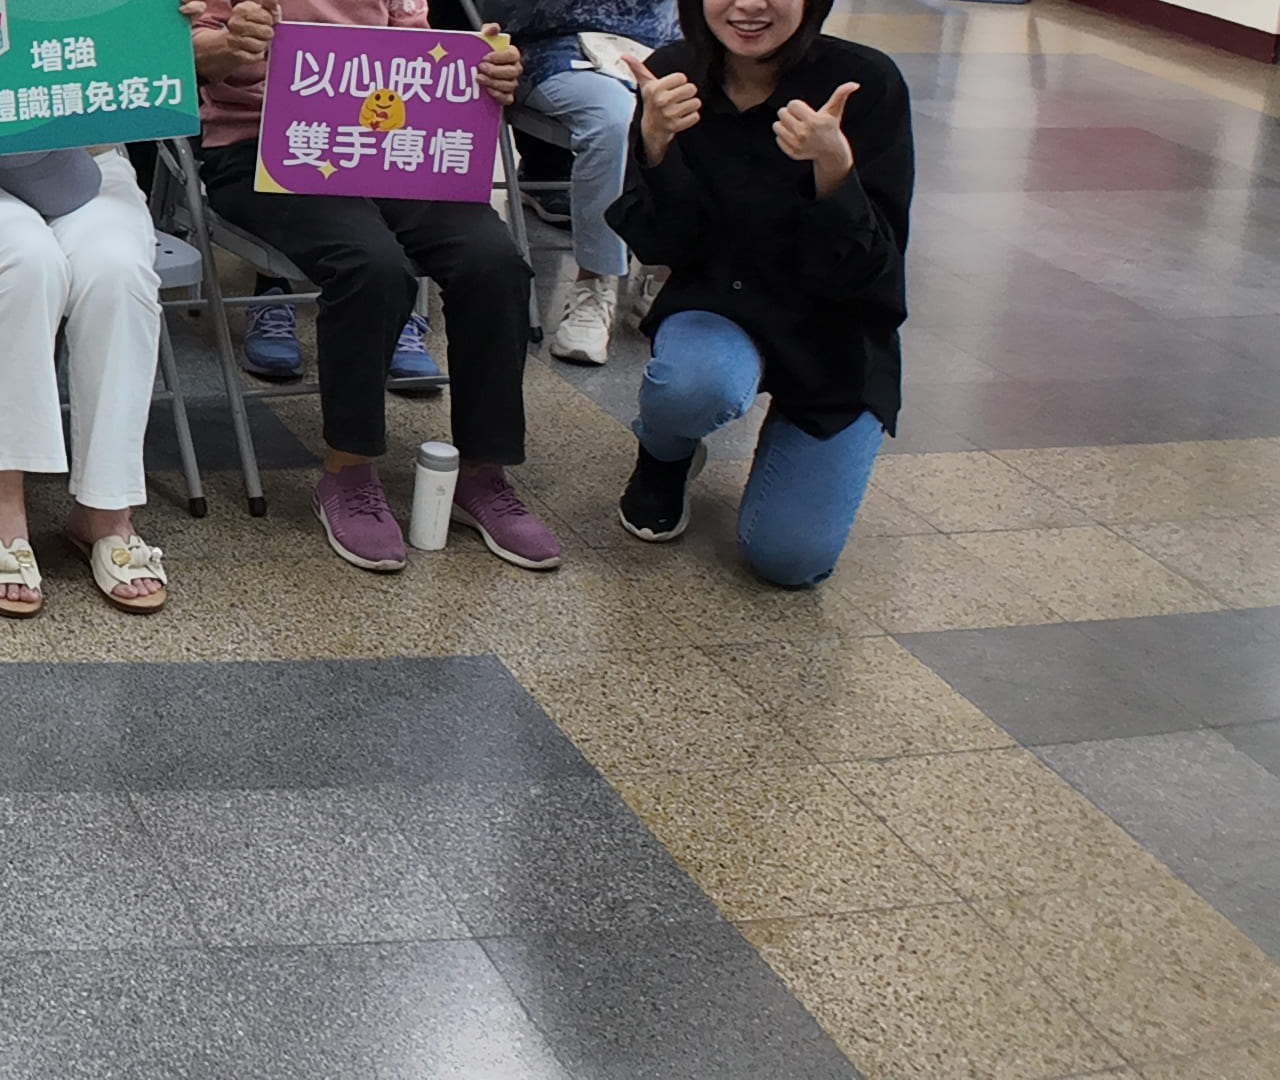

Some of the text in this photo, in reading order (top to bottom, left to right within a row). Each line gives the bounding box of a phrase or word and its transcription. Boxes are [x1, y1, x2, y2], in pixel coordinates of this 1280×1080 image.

[30, 36, 98, 74] 增強
[288, 50, 481, 105] 以心映心
[282, 121, 475, 175] 雙手傳情
